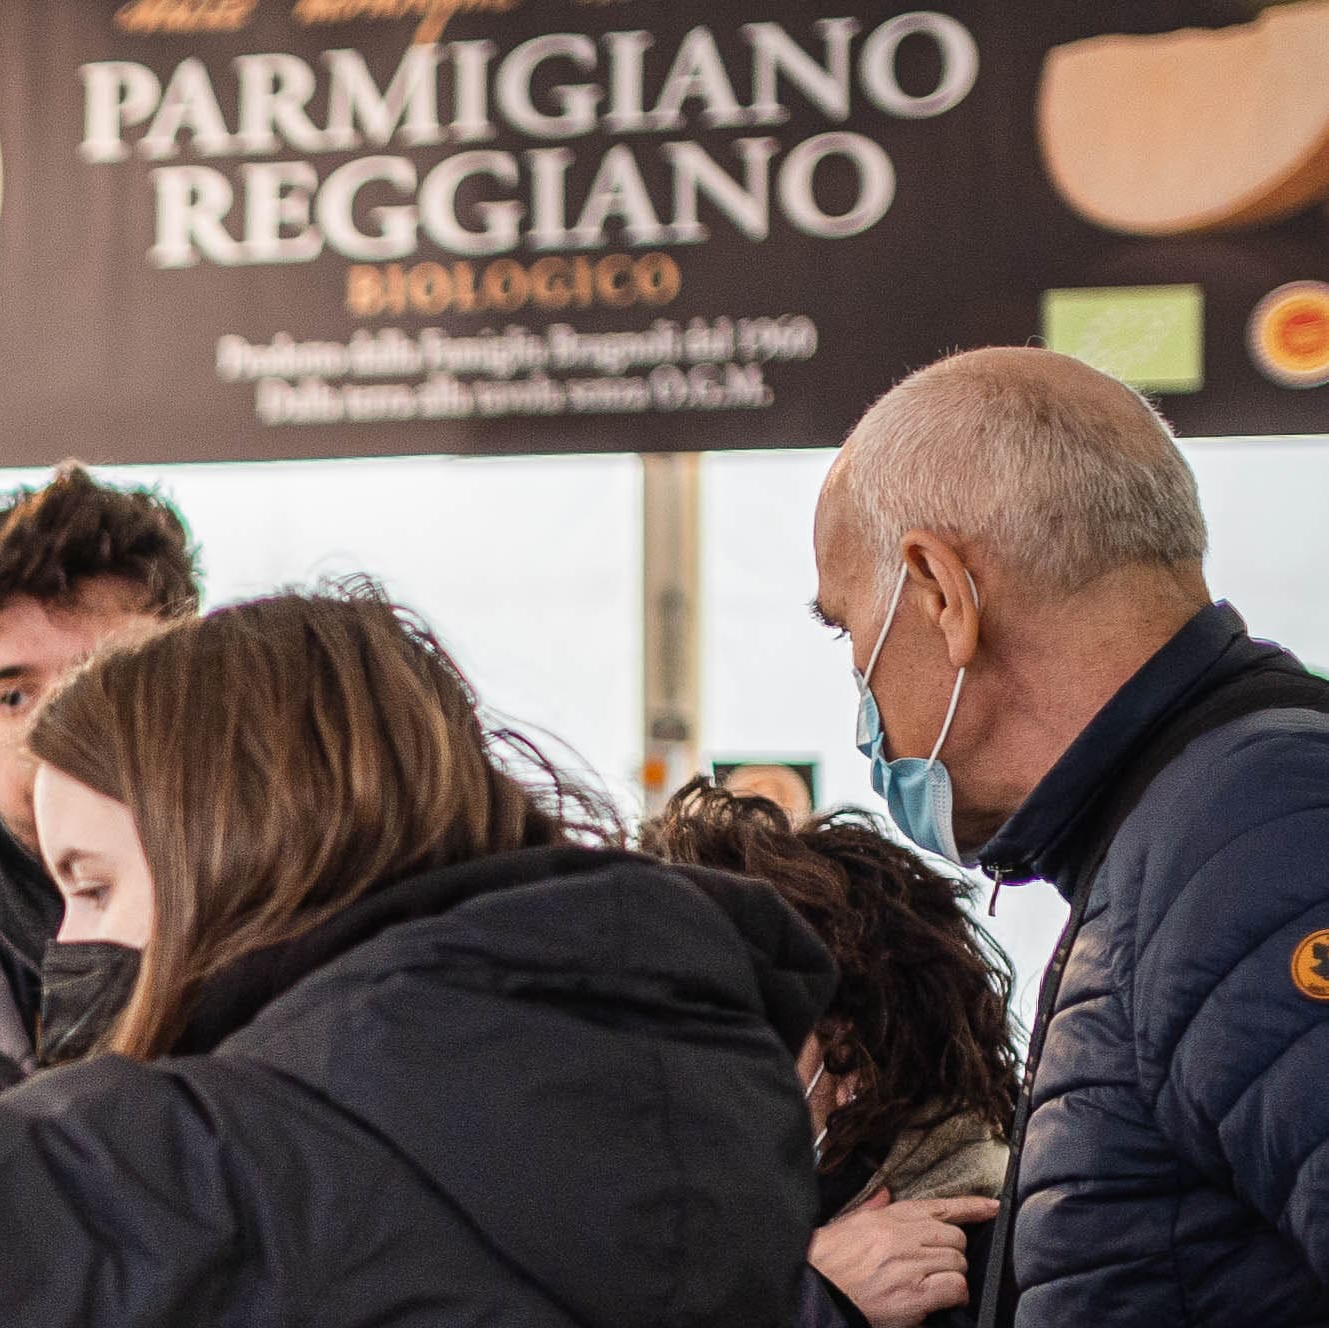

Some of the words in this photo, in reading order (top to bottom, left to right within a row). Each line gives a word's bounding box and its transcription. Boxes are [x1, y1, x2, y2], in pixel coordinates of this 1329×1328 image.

[80, 10, 980, 163] PARMIGIANO
[148, 130, 896, 267] REGGIANO
[347, 254, 682, 318] BIOLOGICO
